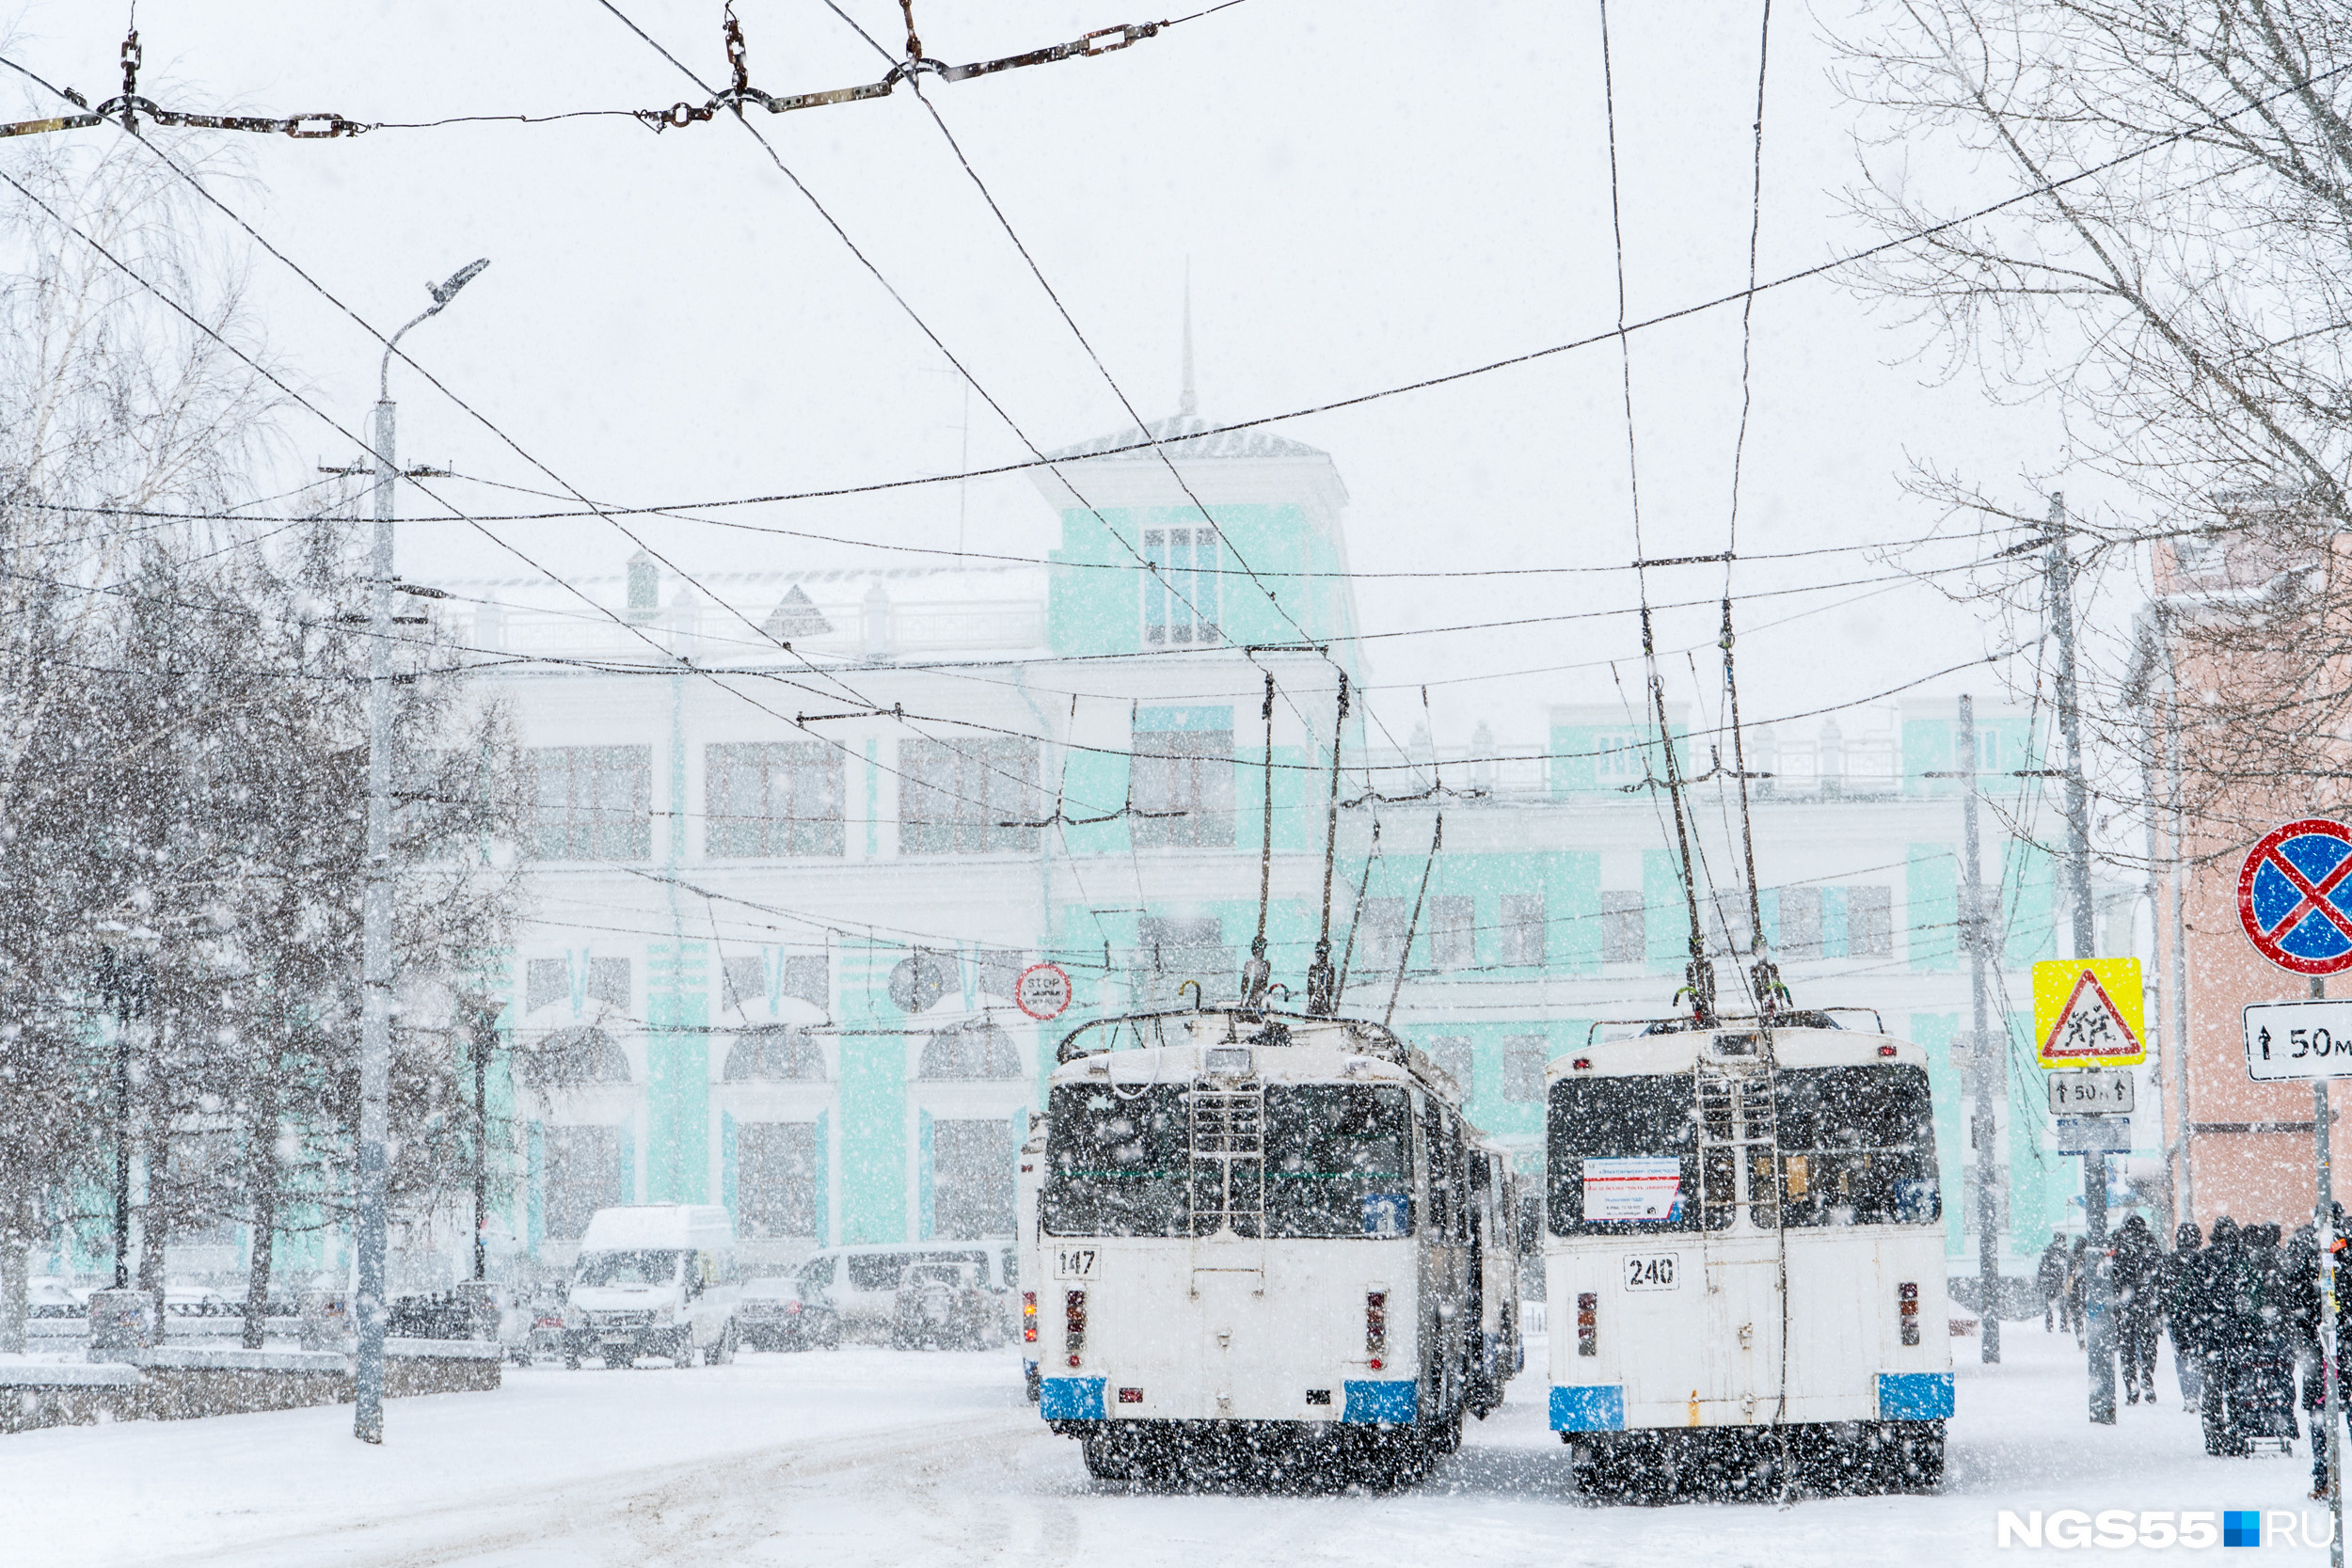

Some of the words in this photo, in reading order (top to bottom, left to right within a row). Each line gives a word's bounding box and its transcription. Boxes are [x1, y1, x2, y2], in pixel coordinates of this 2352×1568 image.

[1027, 978, 1060, 989] STOP
[1059, 1249, 1096, 1275] 147
[1629, 1258, 1674, 1286] 240
